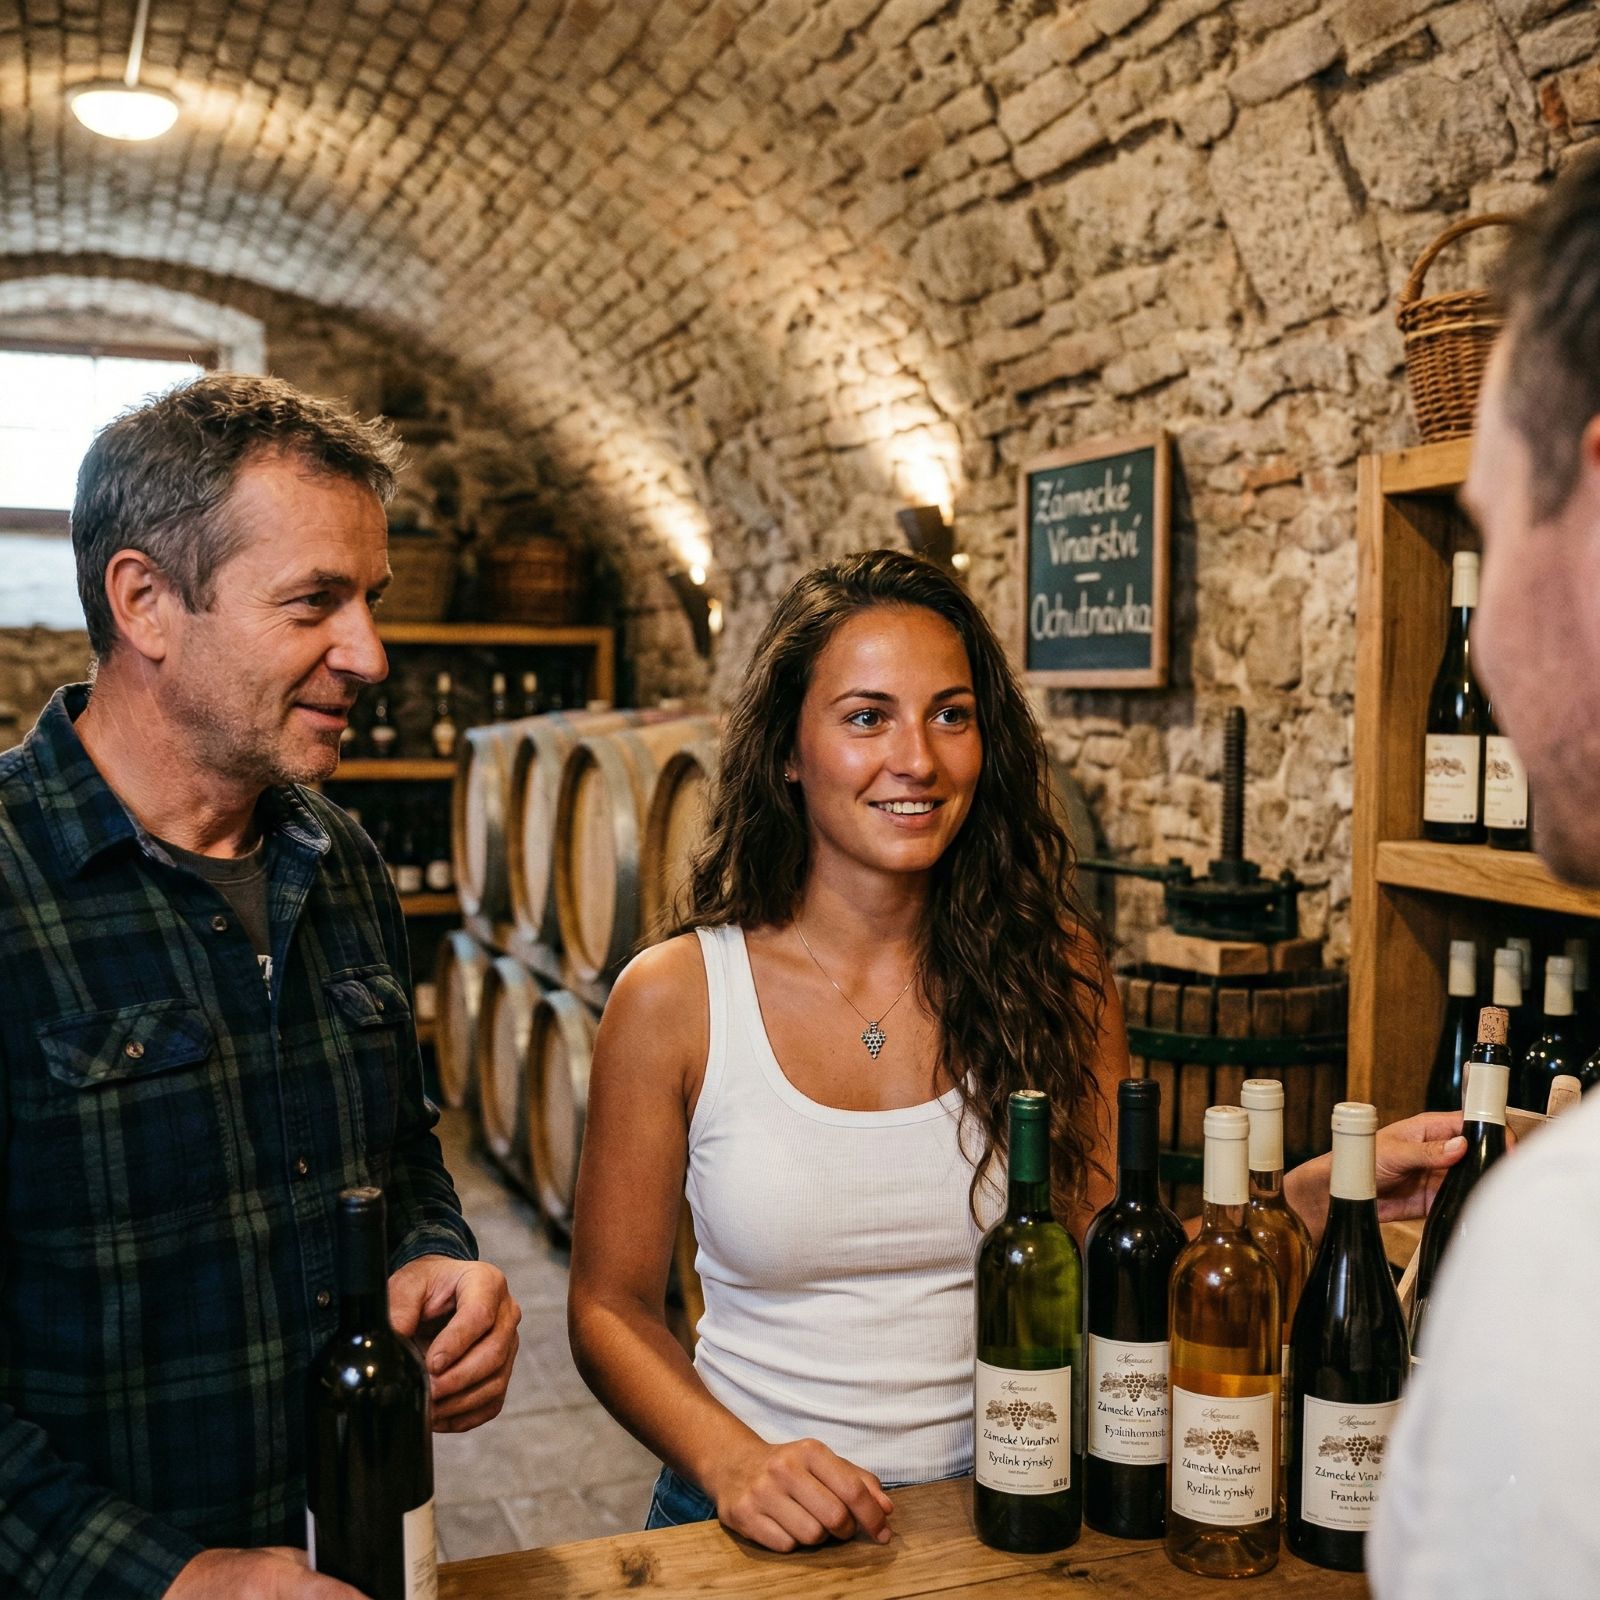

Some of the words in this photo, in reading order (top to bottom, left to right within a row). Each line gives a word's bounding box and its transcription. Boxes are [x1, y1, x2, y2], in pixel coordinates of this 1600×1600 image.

[1034, 464, 1132, 524] Zámecké
[1047, 513, 1143, 566] Vinařství
[1030, 583, 1153, 640] Ochutnávka
[1136, 1406, 1169, 1418] Vinařst
[983, 1428, 1018, 1446] Zámecké
[1022, 1455, 1054, 1470] rýnský
[1182, 1457, 1219, 1475] Zámecké
[1314, 1466, 1356, 1481] Zámecké
[1186, 1480, 1221, 1496] Ryzlink
[1223, 1484, 1256, 1501] rýnský
